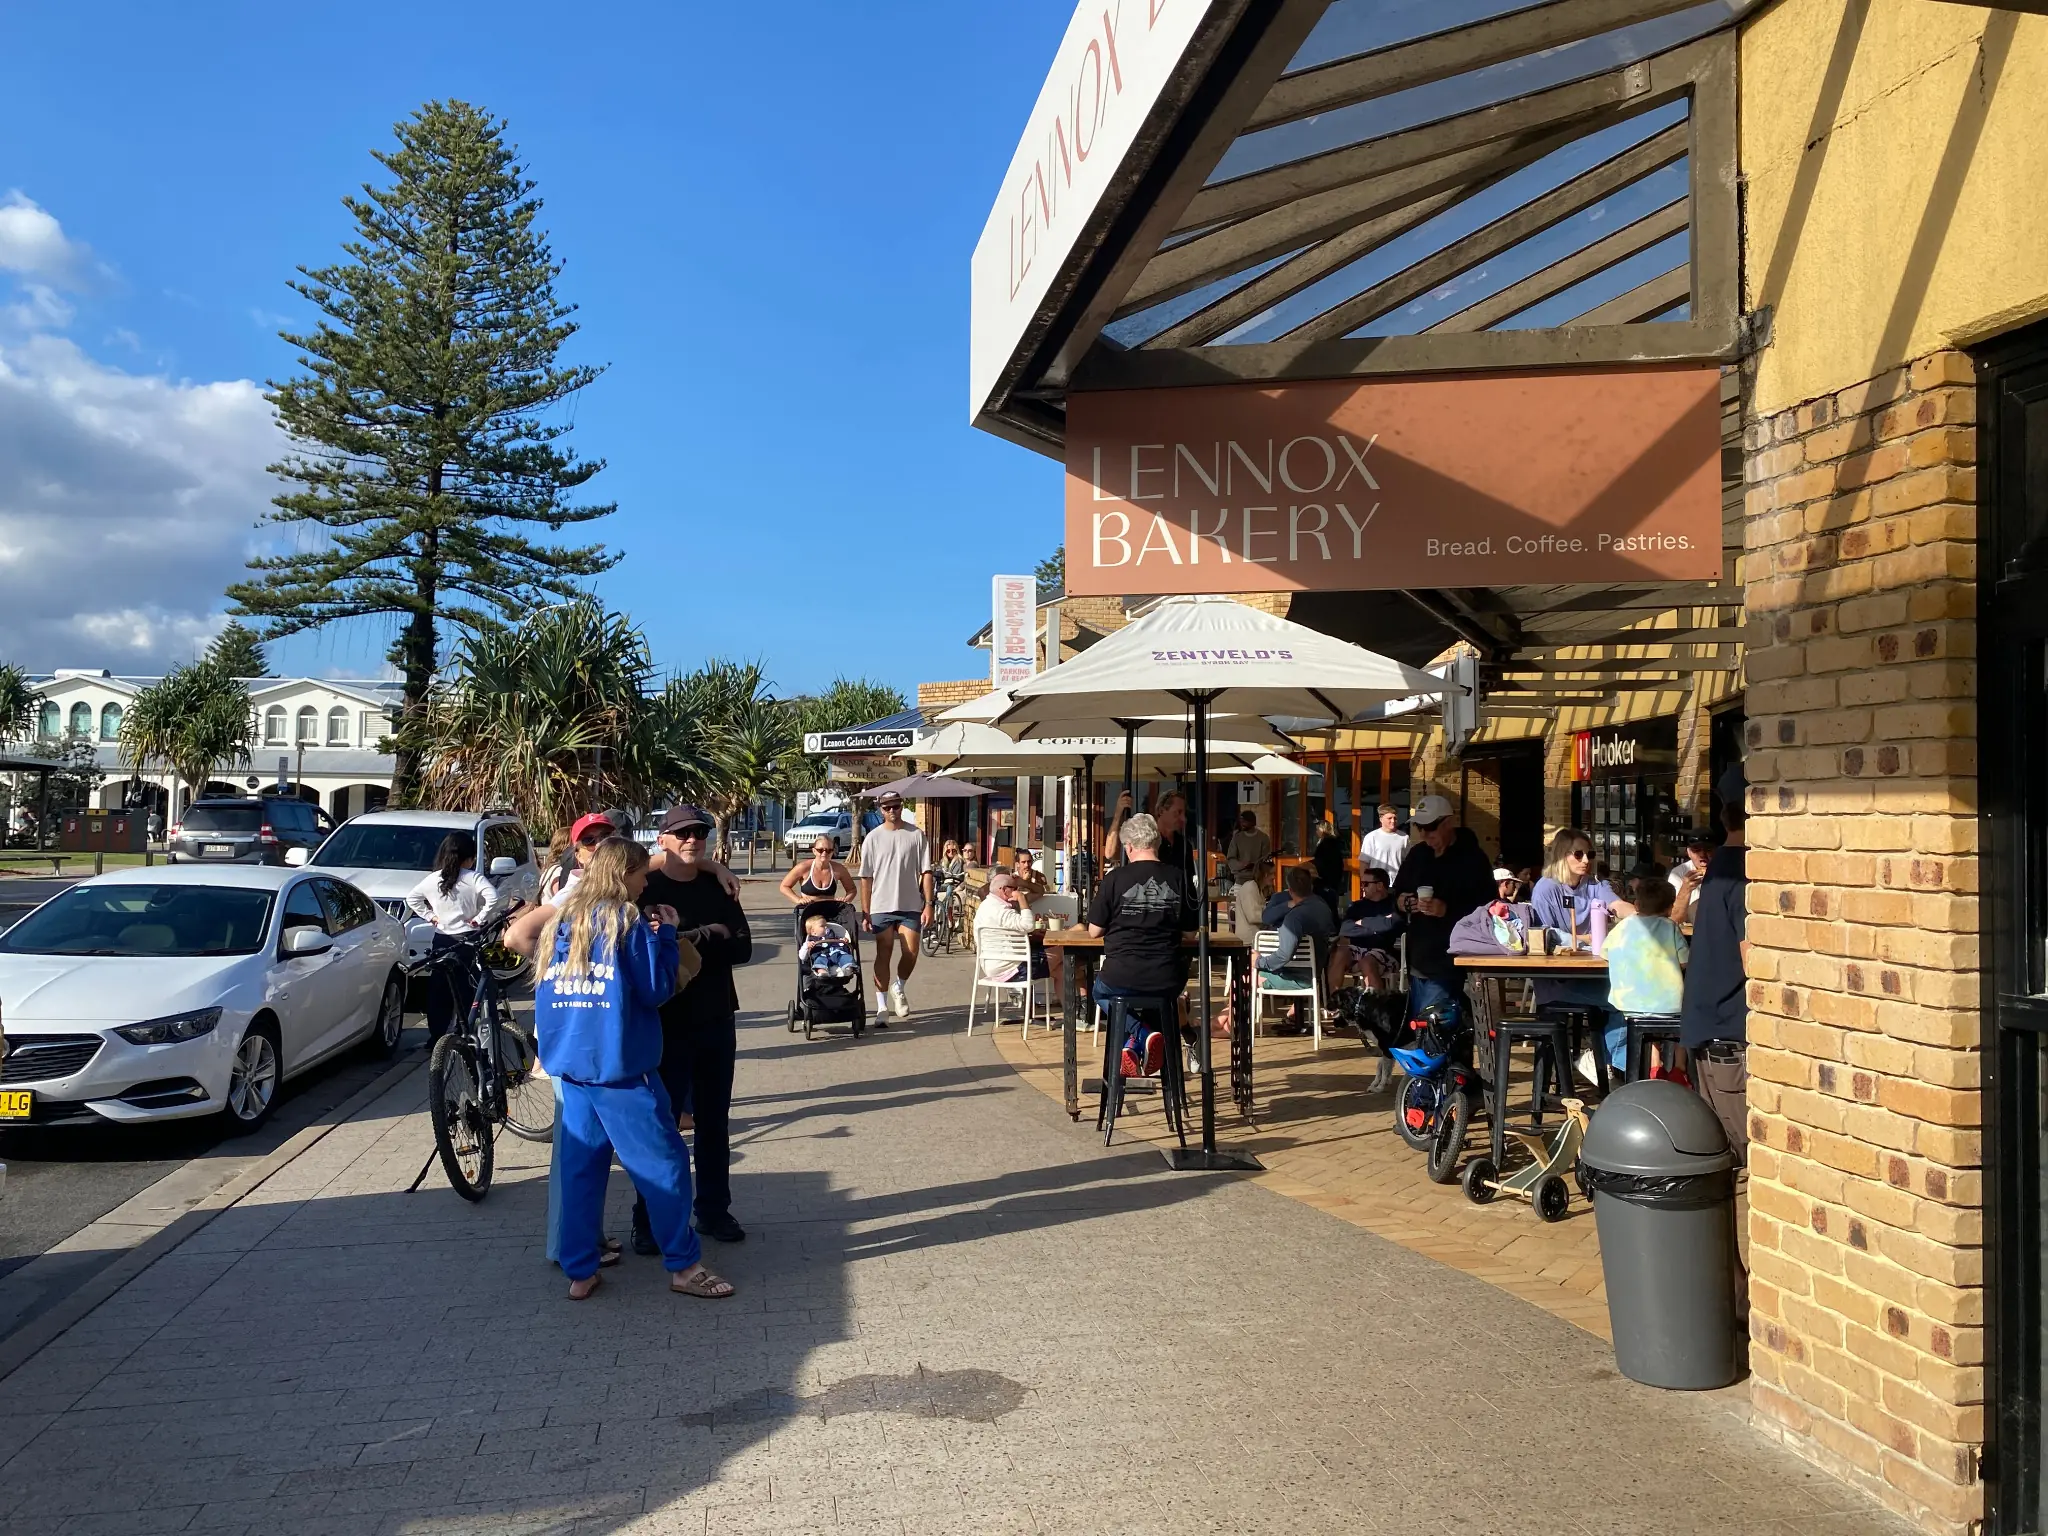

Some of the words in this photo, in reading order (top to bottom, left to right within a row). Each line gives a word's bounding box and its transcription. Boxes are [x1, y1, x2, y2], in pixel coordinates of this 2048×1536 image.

[1010, 0, 1122, 302] LENNOX
[1093, 434, 1380, 500] LENNOX
[1093, 503, 1380, 567] BAKERY
[1427, 538, 1497, 557] Bread.
[1506, 535, 1589, 554] Coffee.
[1599, 532, 1696, 552] Pastries.
[1004, 582, 1026, 654] SURFSIDE
[1151, 649, 1293, 661] ZENTVELD'S
[1000, 667, 1031, 676] PARKING
[823, 737, 846, 748] Lennox
[846, 736, 867, 747] Gelato
[874, 734, 897, 745] Coffee
[897, 733, 911, 745] Co.
[1038, 737, 1116, 745] COFFEE
[833, 759, 865, 767] LENNOX
[872, 759, 903, 767] GELATO
[1579, 737, 1589, 777] LJ
[1591, 732, 1636, 768] Hooker
[847, 771, 876, 779] COFFEE
